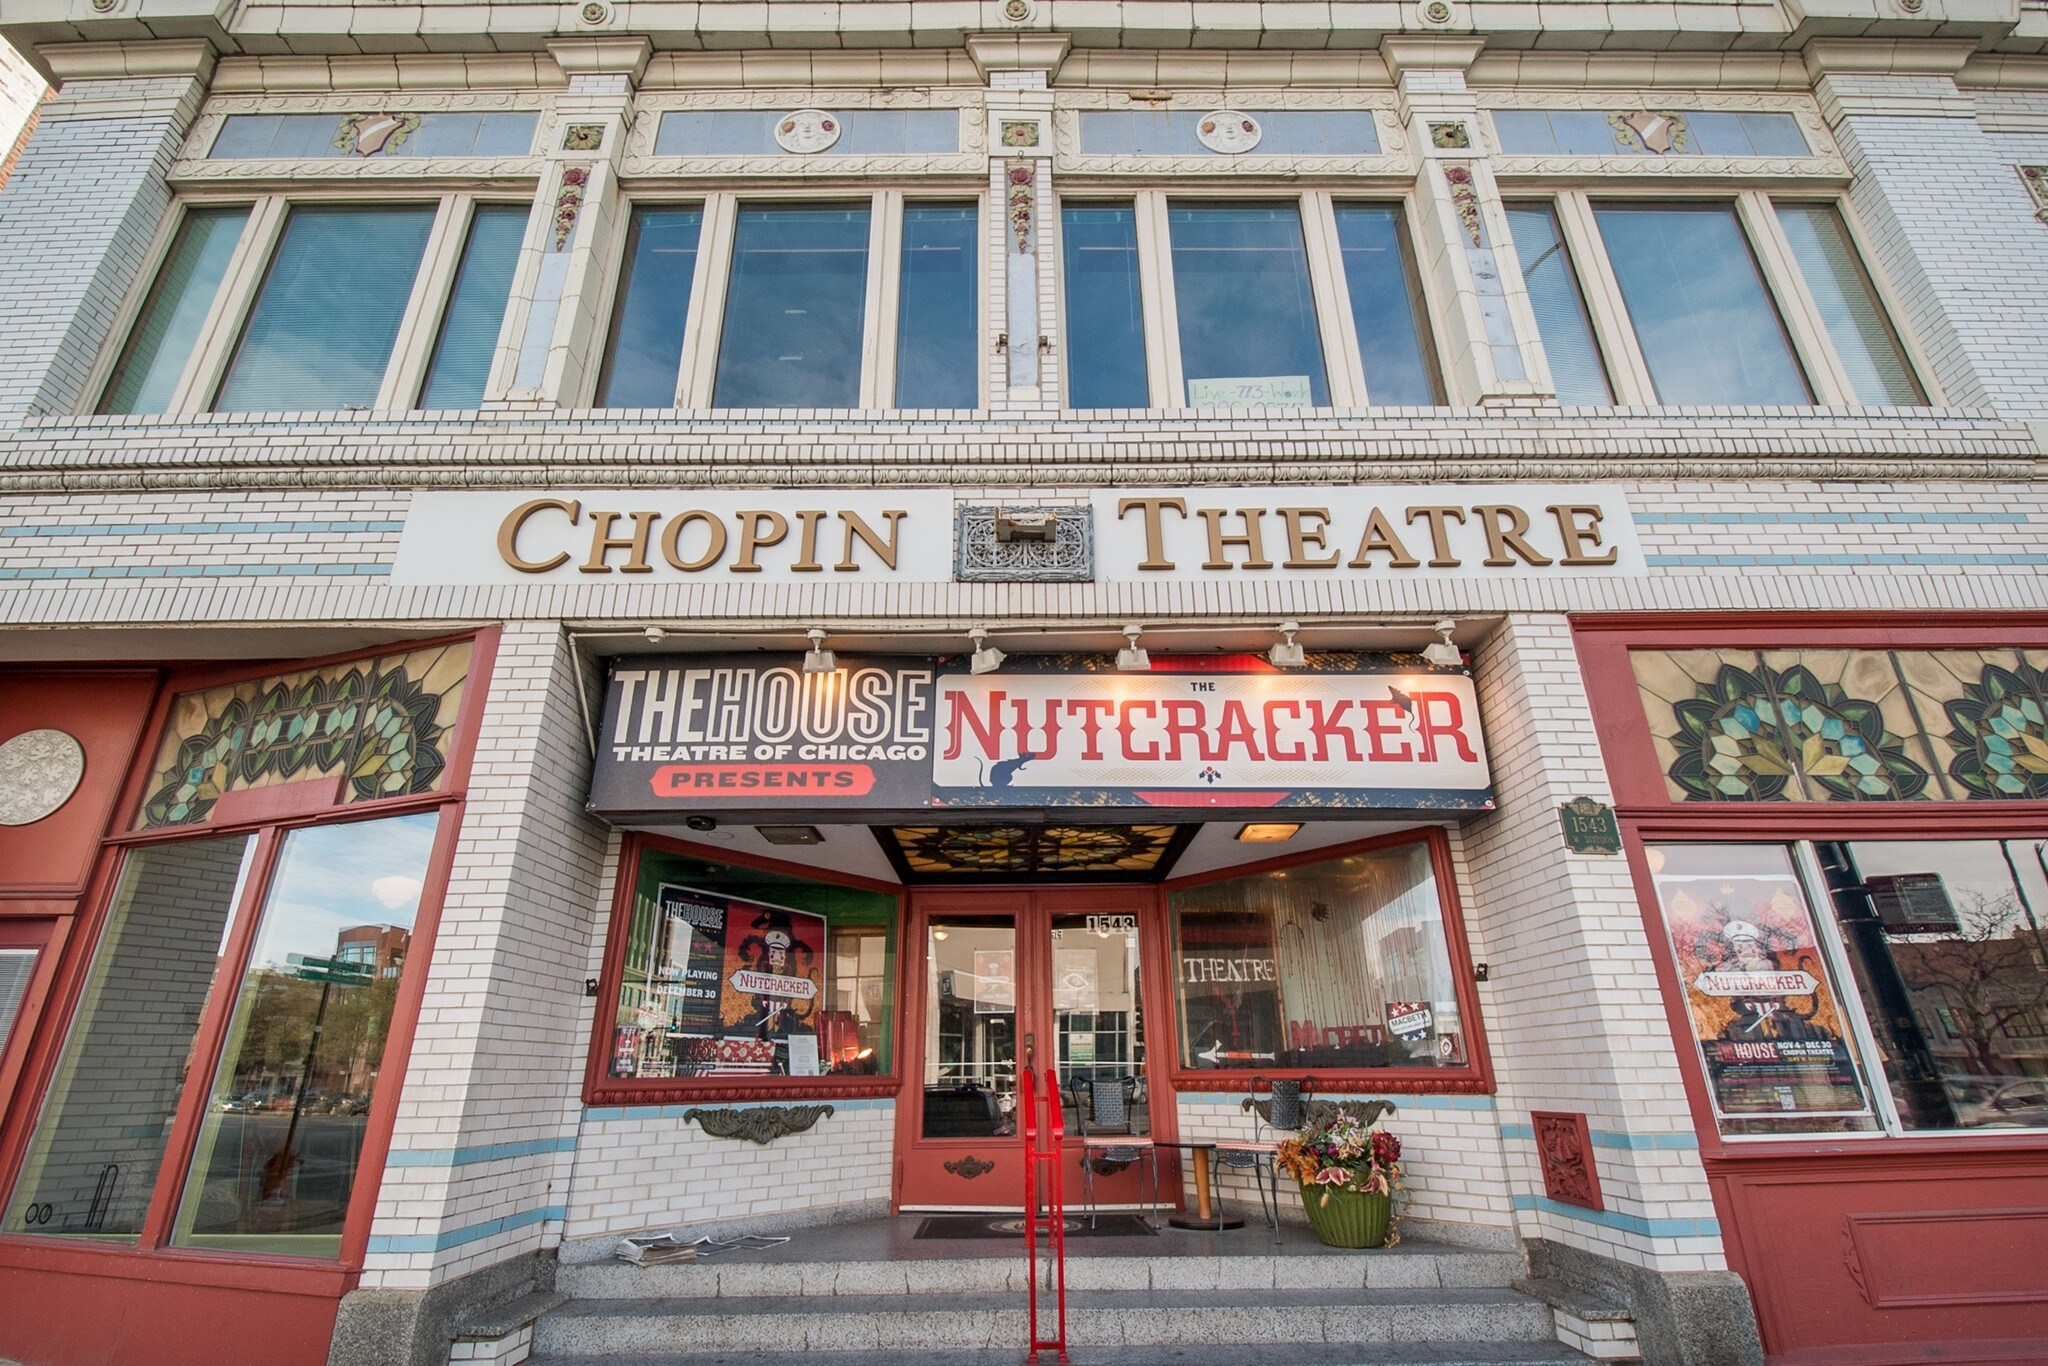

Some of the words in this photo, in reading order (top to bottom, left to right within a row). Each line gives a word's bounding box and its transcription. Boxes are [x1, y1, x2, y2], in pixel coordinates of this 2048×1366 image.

[497, 498, 907, 573] CHOPIN
[1118, 497, 1618, 571] THEATRE
[1190, 682, 1216, 692] THE
[943, 690, 1478, 763] NUTCRACKER
[613, 746, 747, 762] THEATRE
[754, 744, 792, 761] OF
[798, 744, 927, 761] CHICAGO
[670, 771, 855, 789] PRESENTS
[1572, 816, 1607, 833] 1543
[1088, 916, 1134, 933] 1543
[659, 965, 680, 976] NOW
[681, 967, 718, 980] PLAYING
[1183, 957, 1276, 982] THEATRE
[740, 973, 810, 995] NUTCRACKER
[1705, 974, 1807, 990] NUTCRACKER
[657, 985, 704, 998] DECEMBER
[704, 988, 717, 999] 30
[1391, 1010, 1427, 1027] MACBETH
[1734, 1042, 1778, 1059] HOUSE
[1777, 1041, 1794, 1050] NOV
[1805, 1041, 1820, 1049] DEC
[1821, 1041, 1832, 1049] 30
